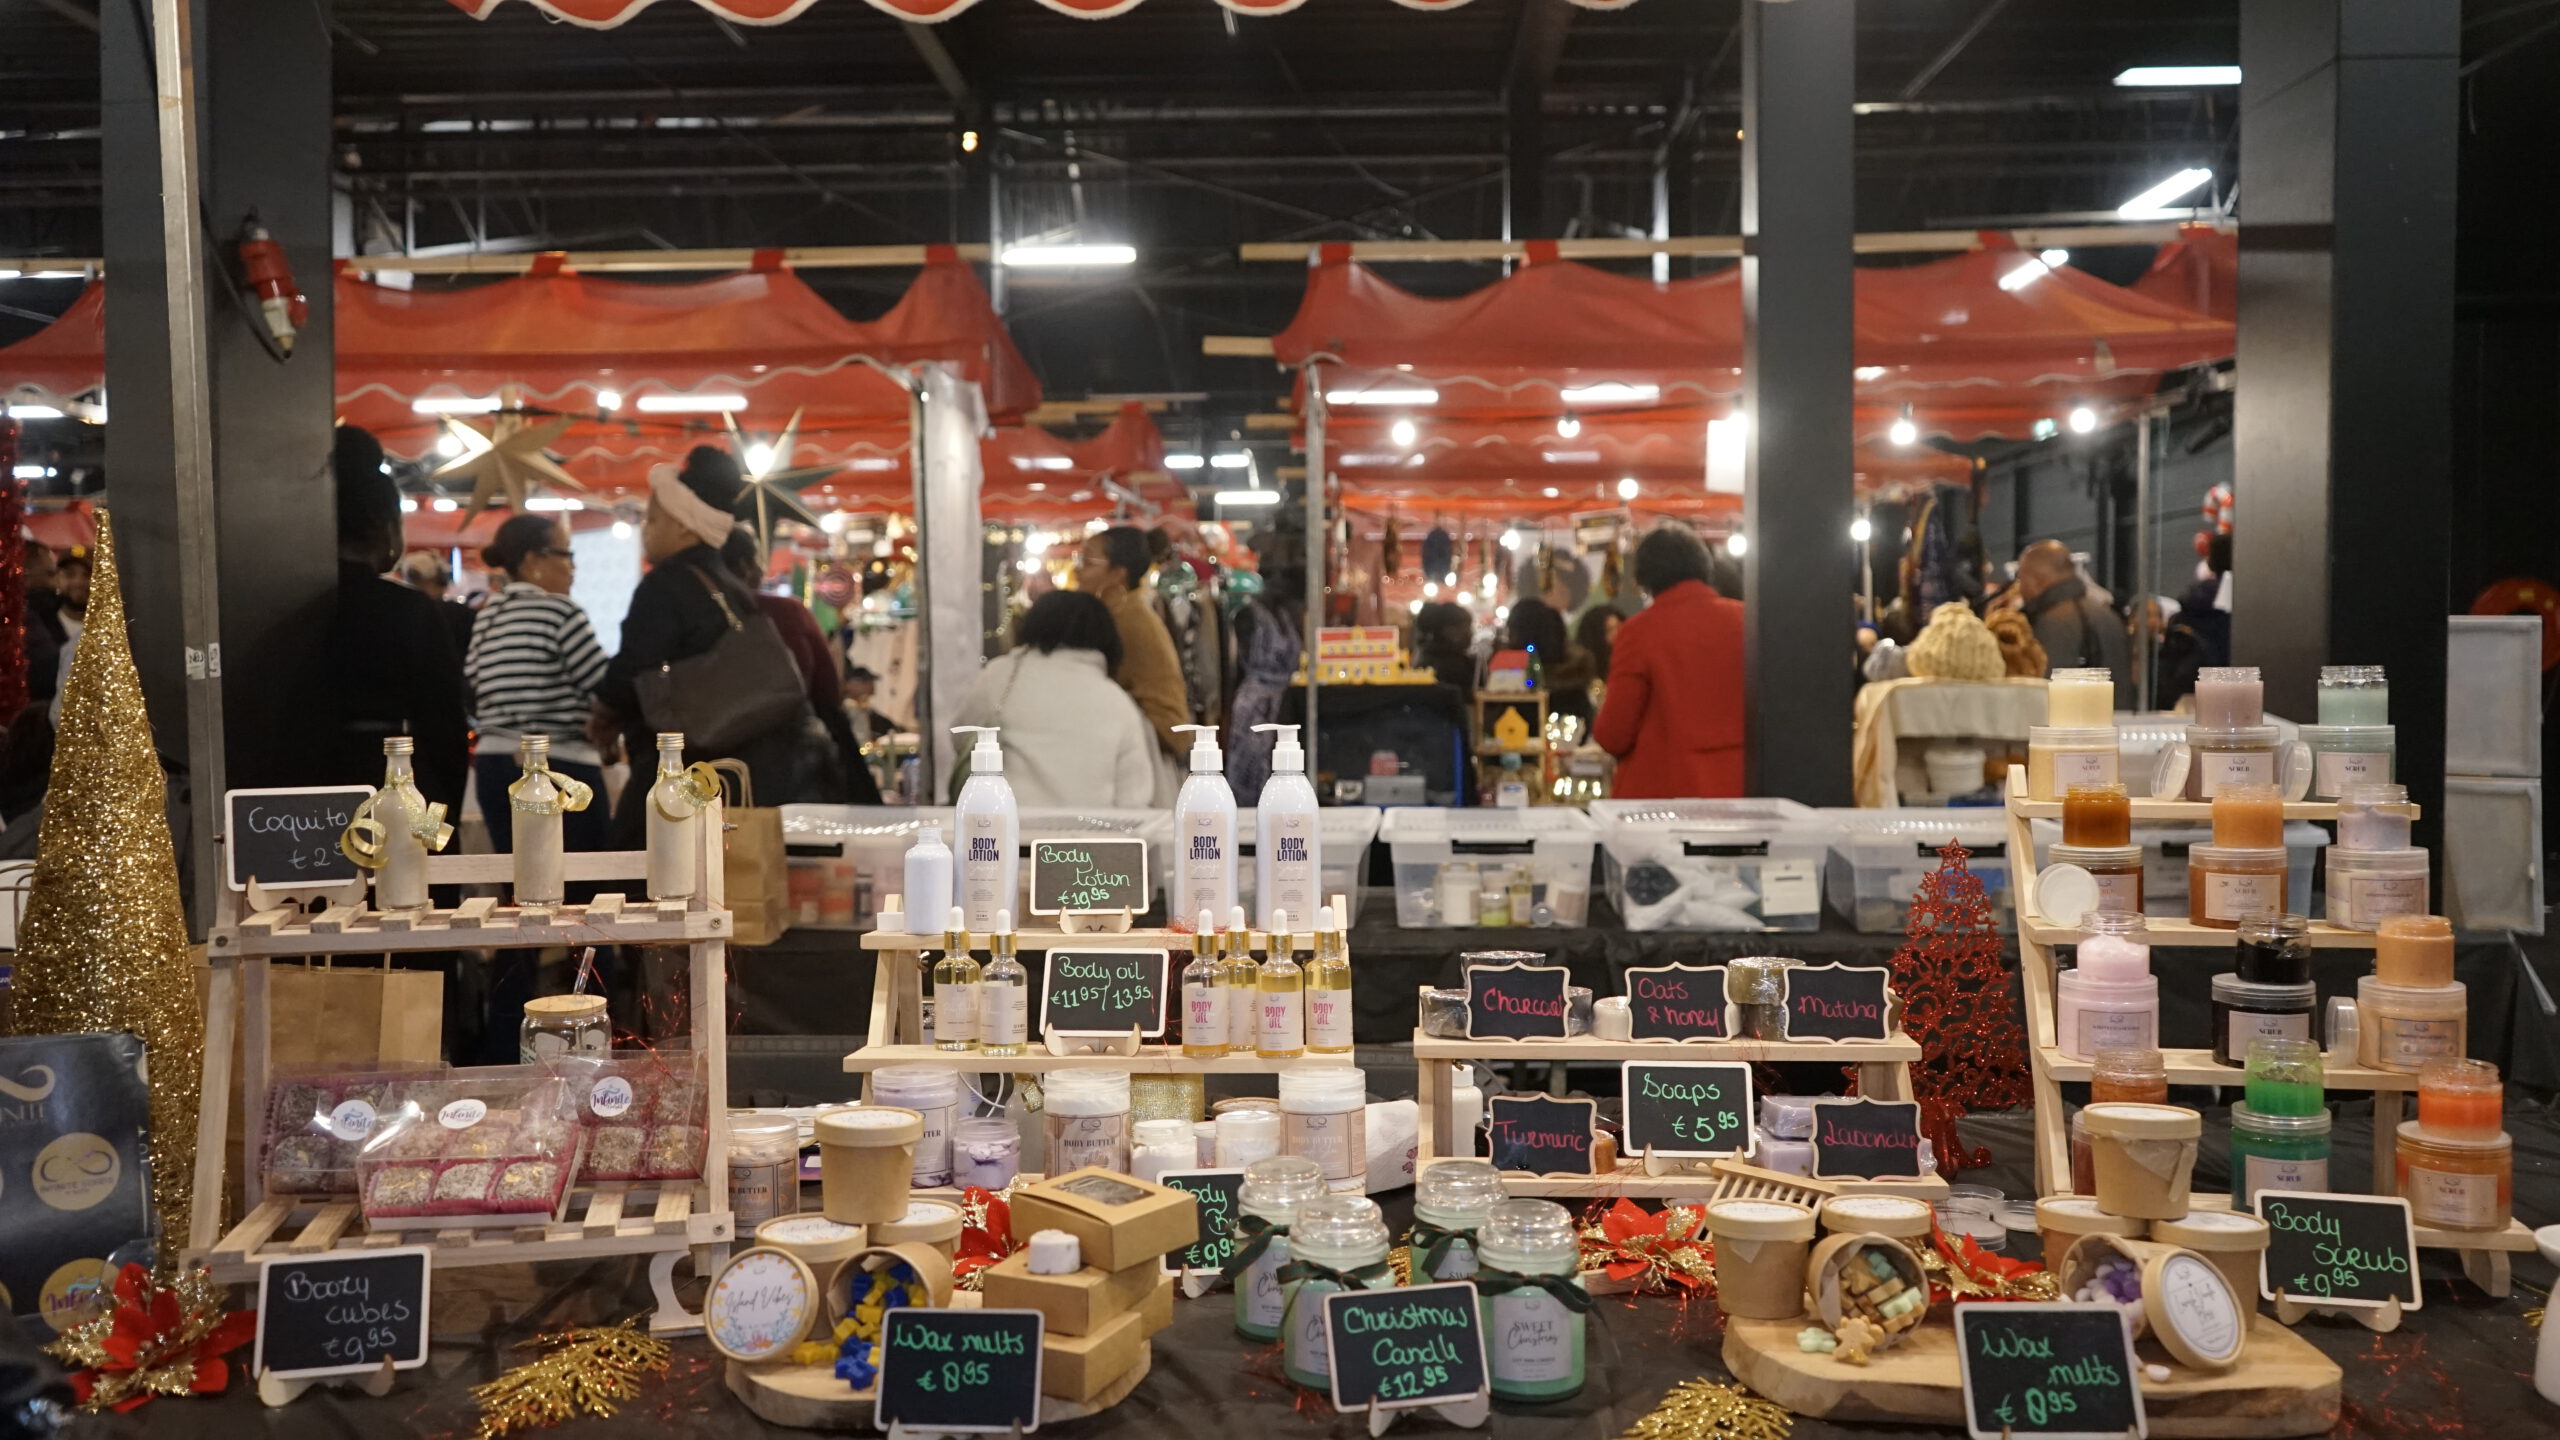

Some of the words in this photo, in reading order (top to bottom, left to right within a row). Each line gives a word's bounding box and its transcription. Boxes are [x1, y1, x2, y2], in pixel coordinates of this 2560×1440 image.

[248, 806, 348, 842] Coquito
[972, 837, 996, 849] BODY
[1193, 836, 1217, 848] BODY
[1281, 837, 1305, 849] BODY
[969, 849, 999, 861] LOTION
[1039, 845, 1093, 873] Body
[1190, 847, 1221, 860] LOTION
[1277, 849, 1308, 861] LOTION
[1058, 956, 1111, 988] Body
[1116, 961, 1145, 980] oil
[1637, 977, 1689, 999] Oats
[1191, 1000, 1213, 1012] BODY
[1313, 1003, 1334, 1014] BODY
[1482, 987, 1563, 1017] Charcoal
[1797, 994, 1877, 1020] Matcha
[1195, 1011, 1209, 1023] OIL
[1265, 1006, 1286, 1018] BODY
[1317, 1014, 1330, 1025] OIL
[1269, 1017, 1282, 1029] OIL
[2258, 1028, 2283, 1036] SCRUB
[1642, 1072, 1721, 1107] Soaps
[592, 1093, 630, 1108] Infinite
[1064, 1139, 1084, 1147] BODY
[1086, 1138, 1116, 1147] BUTTER
[1493, 1120, 1586, 1151] Turmeric
[2269, 1202, 2342, 1246] Body
[284, 1271, 369, 1301] Boozy
[1343, 1302, 1468, 1333] Christmas
[1513, 1320, 1554, 1332] SWEET
[893, 1324, 955, 1352] Wax
[1507, 1327, 1558, 1350] Christmas
[1979, 1327, 2055, 1358] Wax
[1372, 1333, 1463, 1366] Candle
